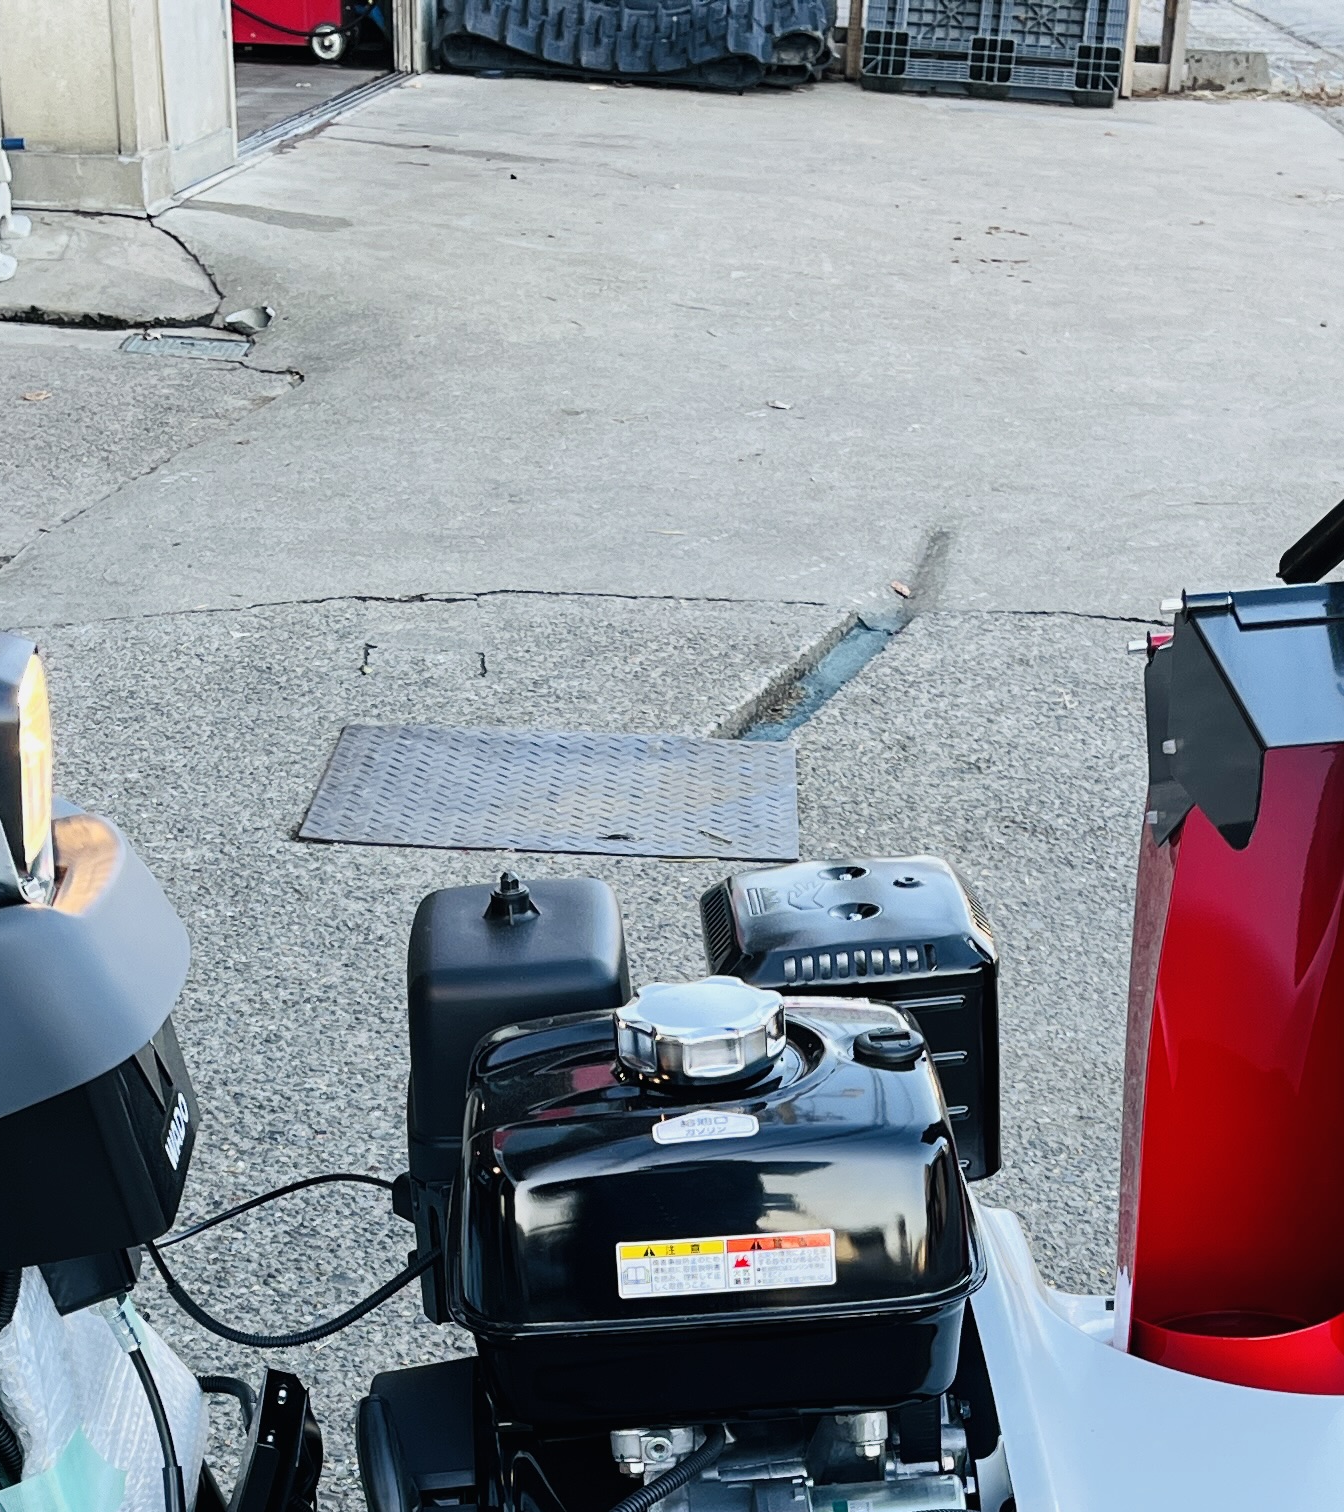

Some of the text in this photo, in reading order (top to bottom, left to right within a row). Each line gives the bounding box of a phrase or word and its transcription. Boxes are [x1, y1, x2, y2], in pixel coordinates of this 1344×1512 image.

[685, 1126, 727, 1137] ガソリン
[665, 1244, 700, 1256] 注意
